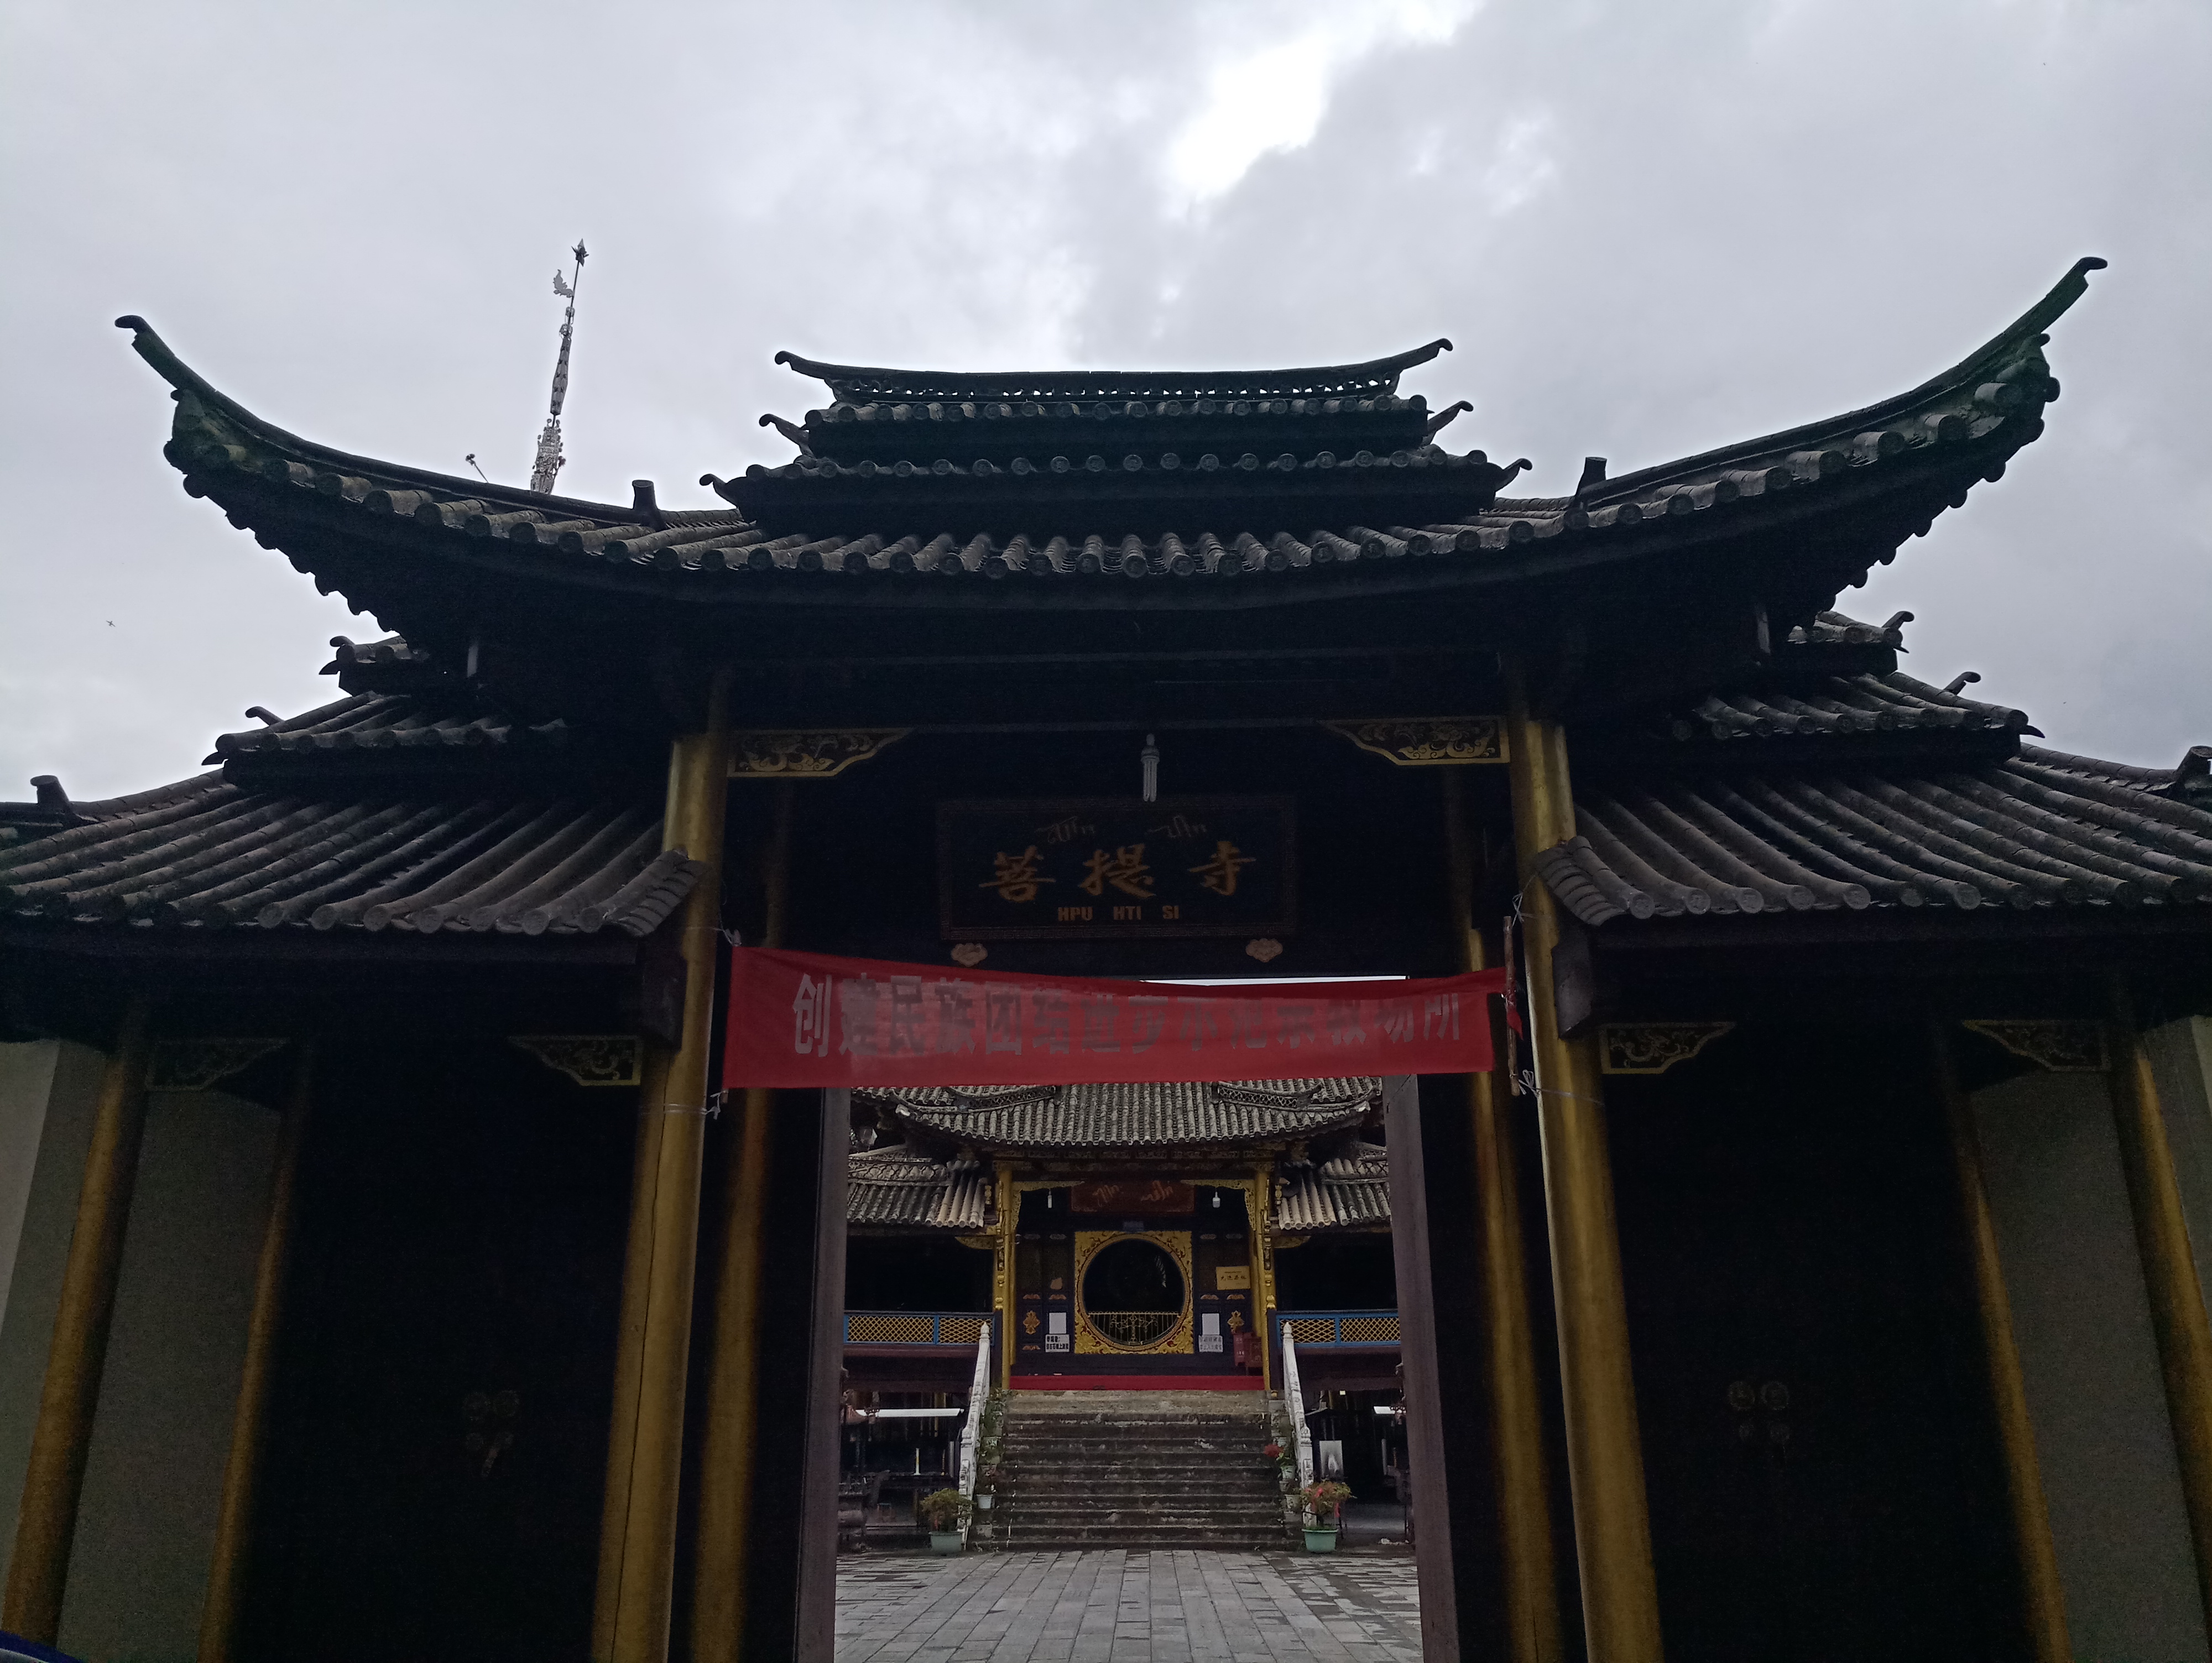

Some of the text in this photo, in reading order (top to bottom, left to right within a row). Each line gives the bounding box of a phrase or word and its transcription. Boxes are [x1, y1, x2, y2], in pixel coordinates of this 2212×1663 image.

[979, 840, 1257, 903] 菩提寺
[1057, 904, 1180, 922] HPU HTI SI
